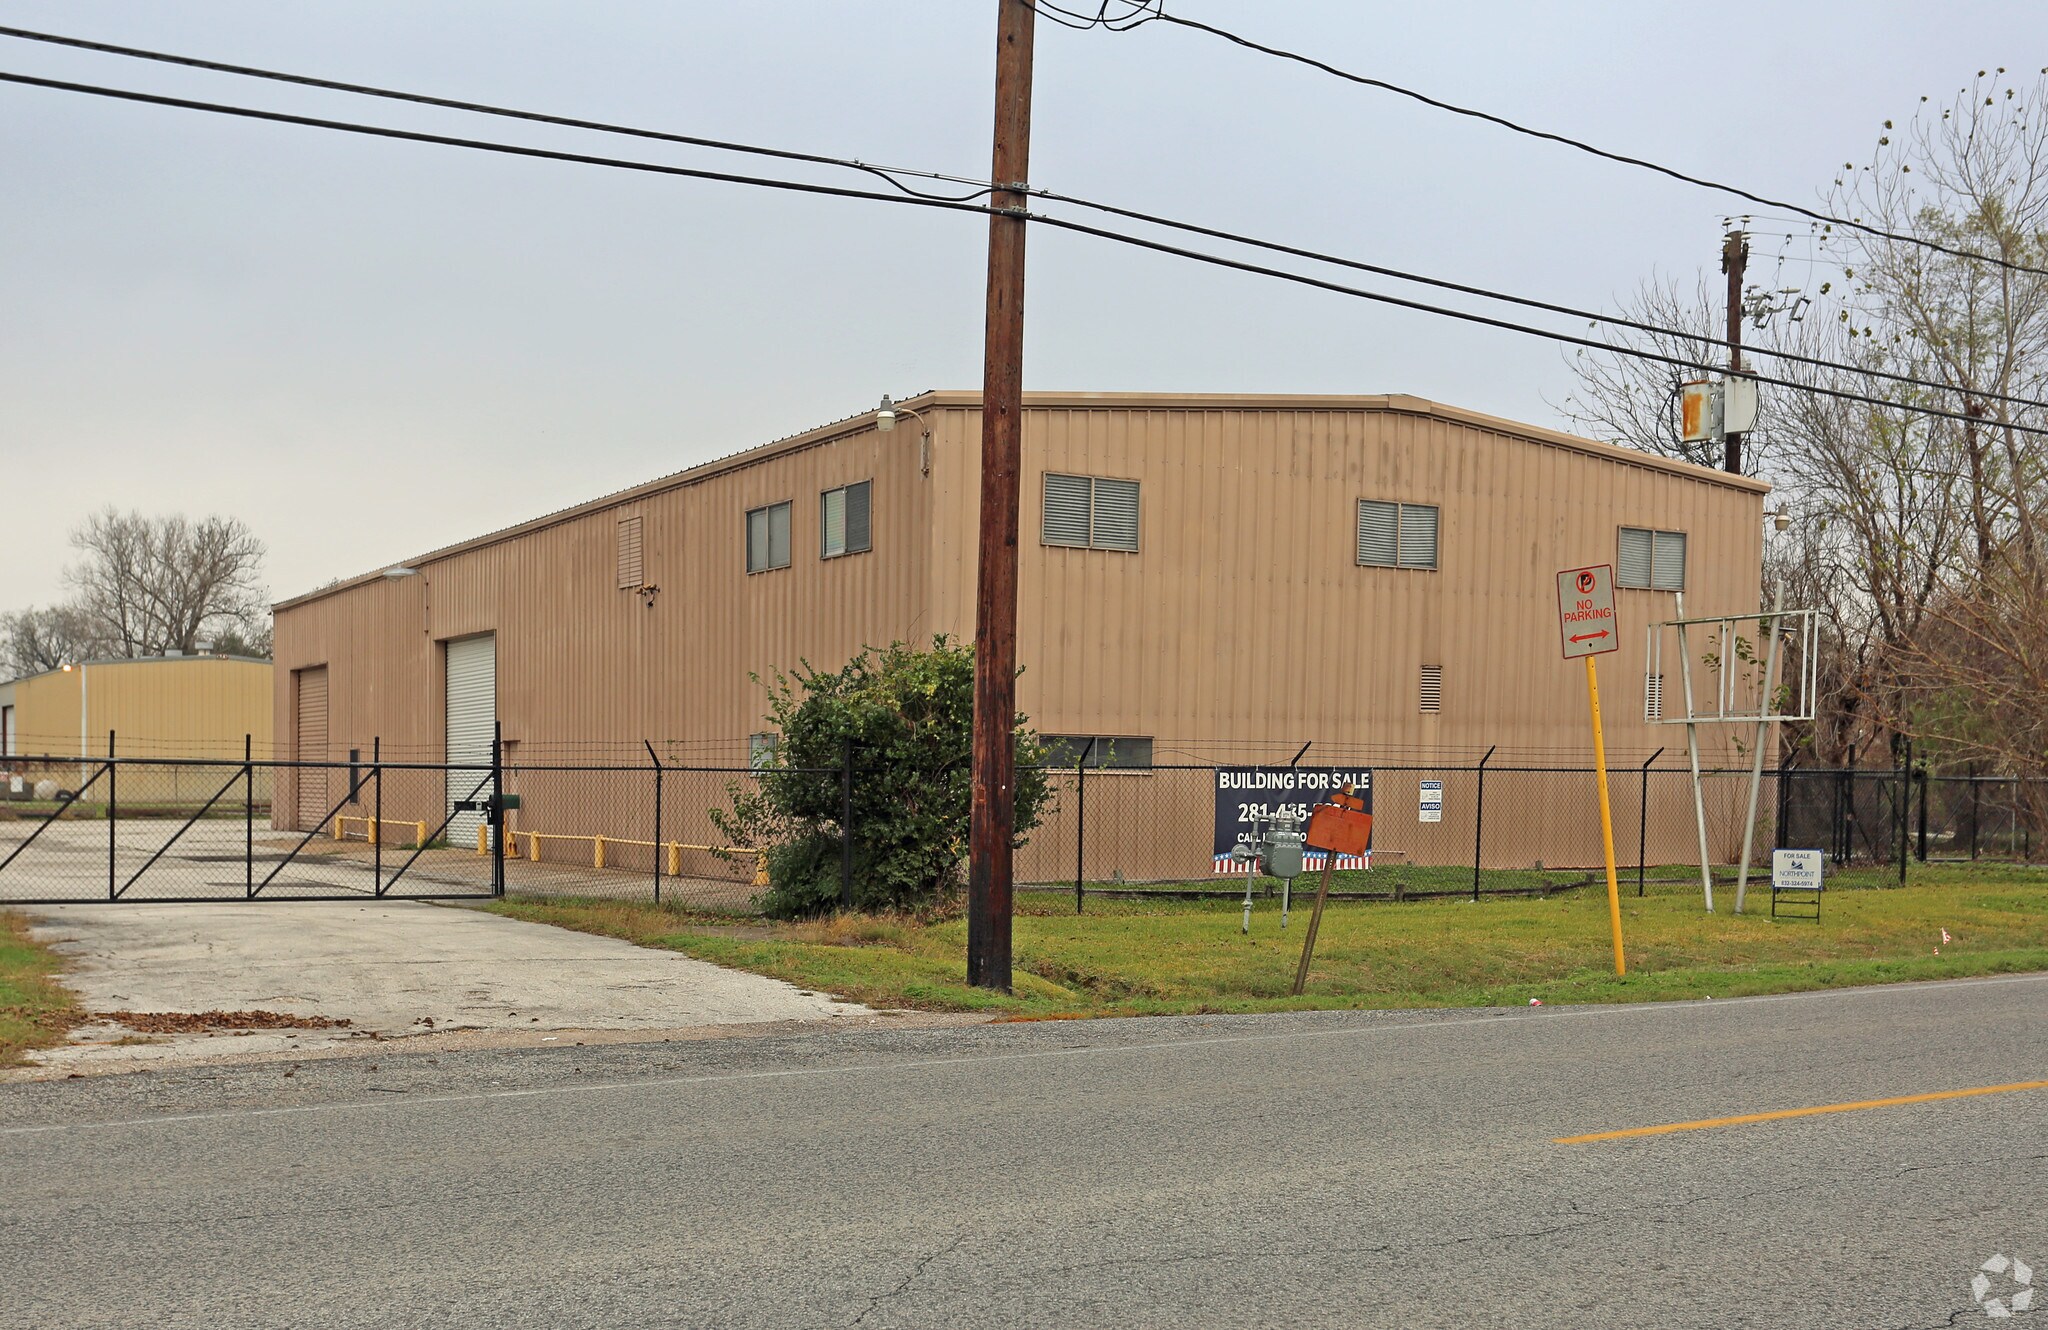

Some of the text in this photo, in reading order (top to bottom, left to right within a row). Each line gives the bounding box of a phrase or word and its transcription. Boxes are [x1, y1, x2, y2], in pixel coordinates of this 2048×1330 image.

[1576, 599, 1593, 611] NO
[1564, 607, 1612, 623] PARKING
[1219, 772, 1370, 790] BUILDING FOR SALE
